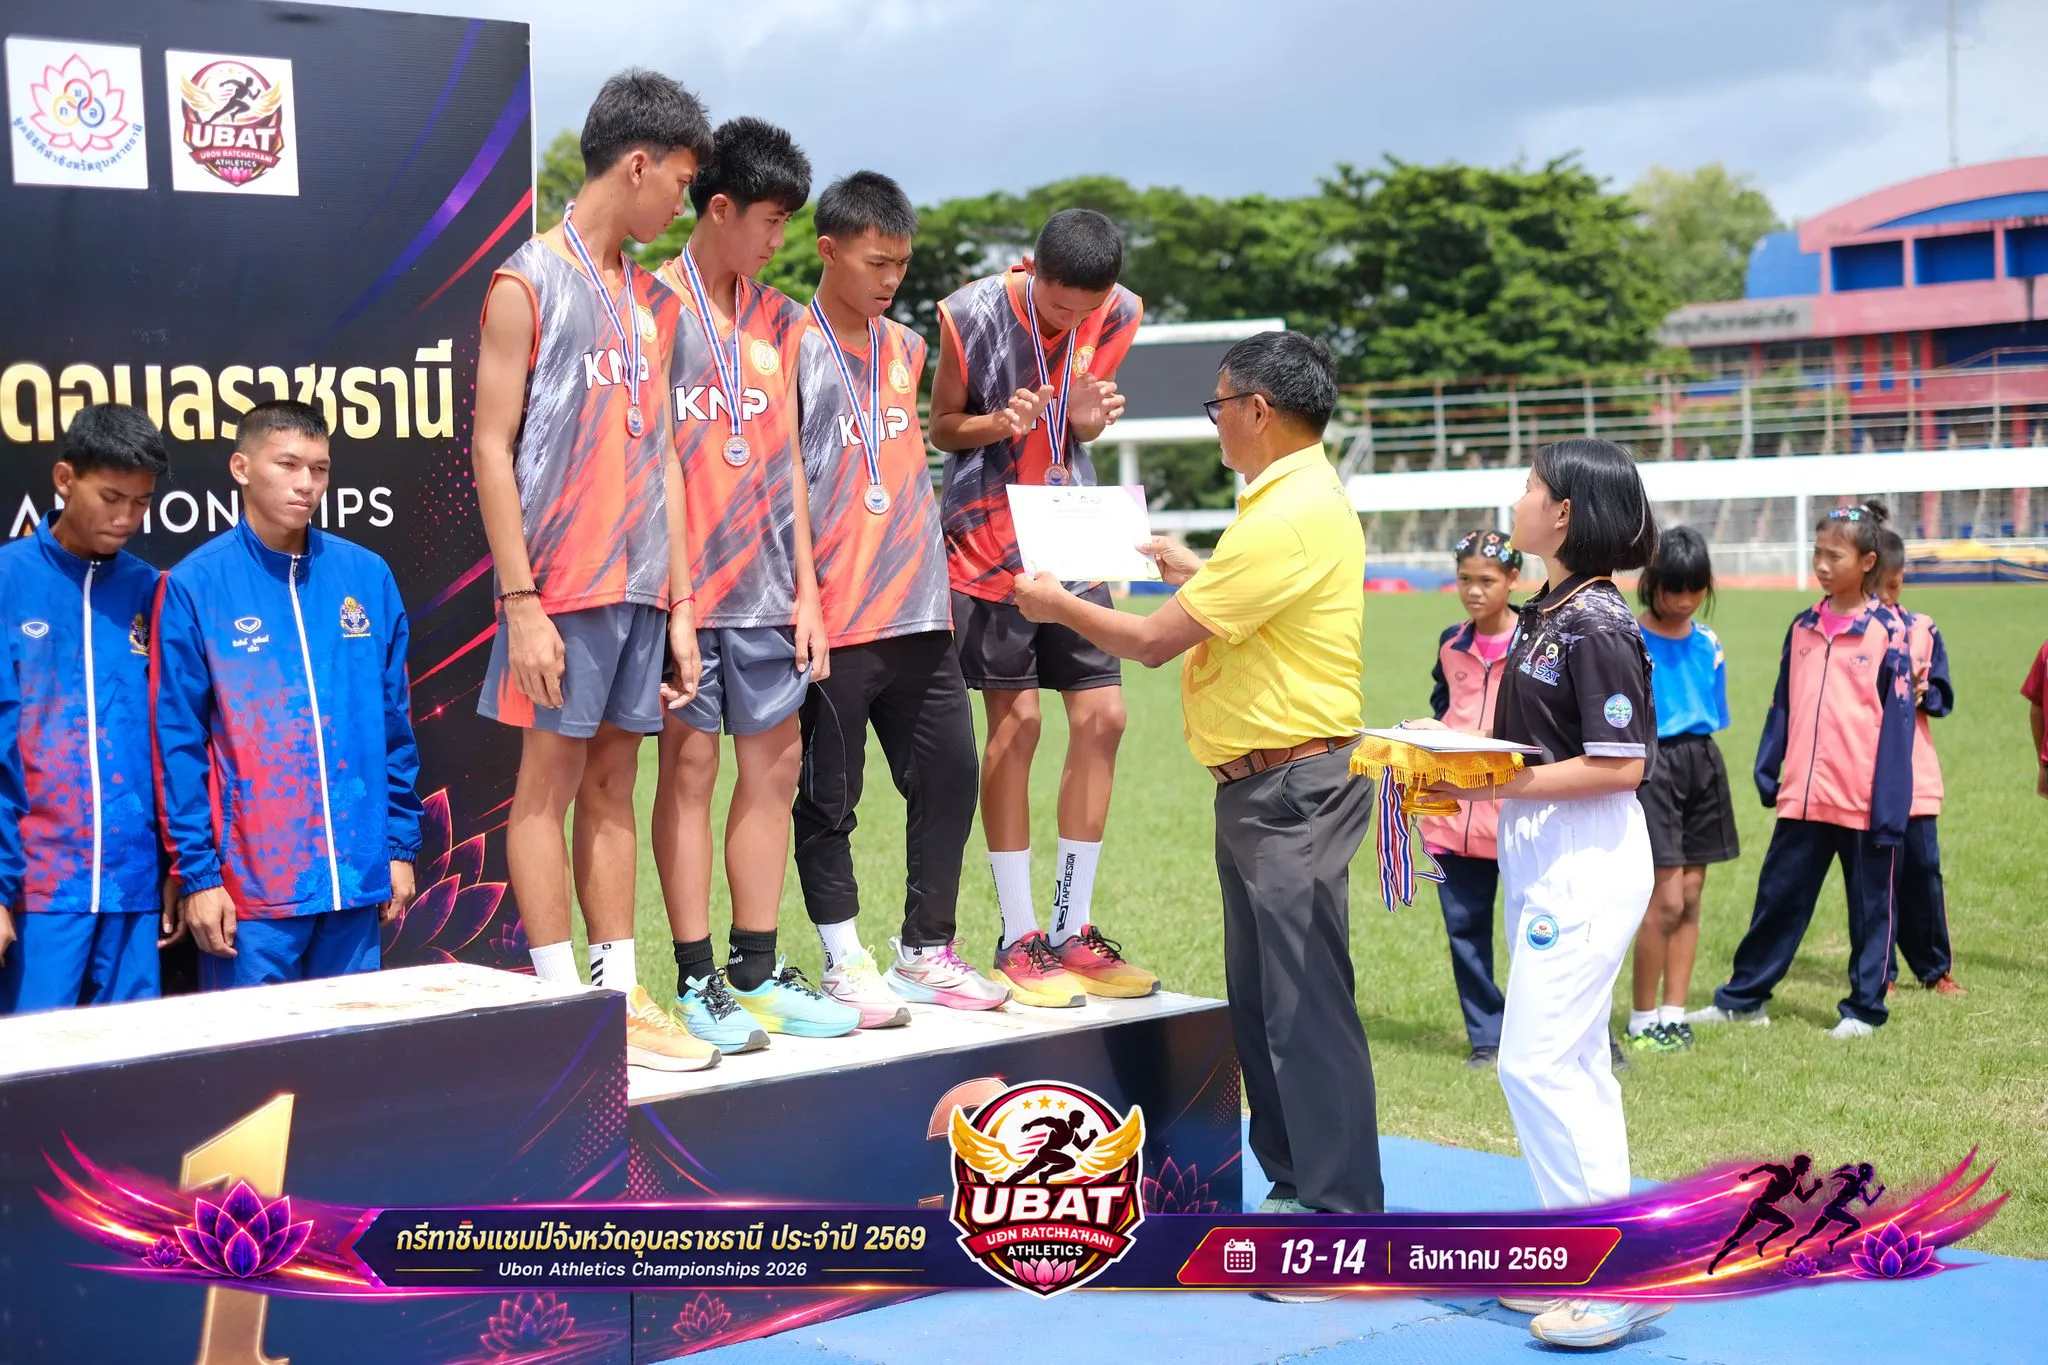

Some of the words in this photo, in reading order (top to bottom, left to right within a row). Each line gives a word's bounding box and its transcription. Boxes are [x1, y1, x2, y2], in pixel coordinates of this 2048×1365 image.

[191, 123, 277, 152] UBAT
[215, 159, 257, 168] ATHLETICS
[1061, 852, 1076, 905] TAPEDESIGN
